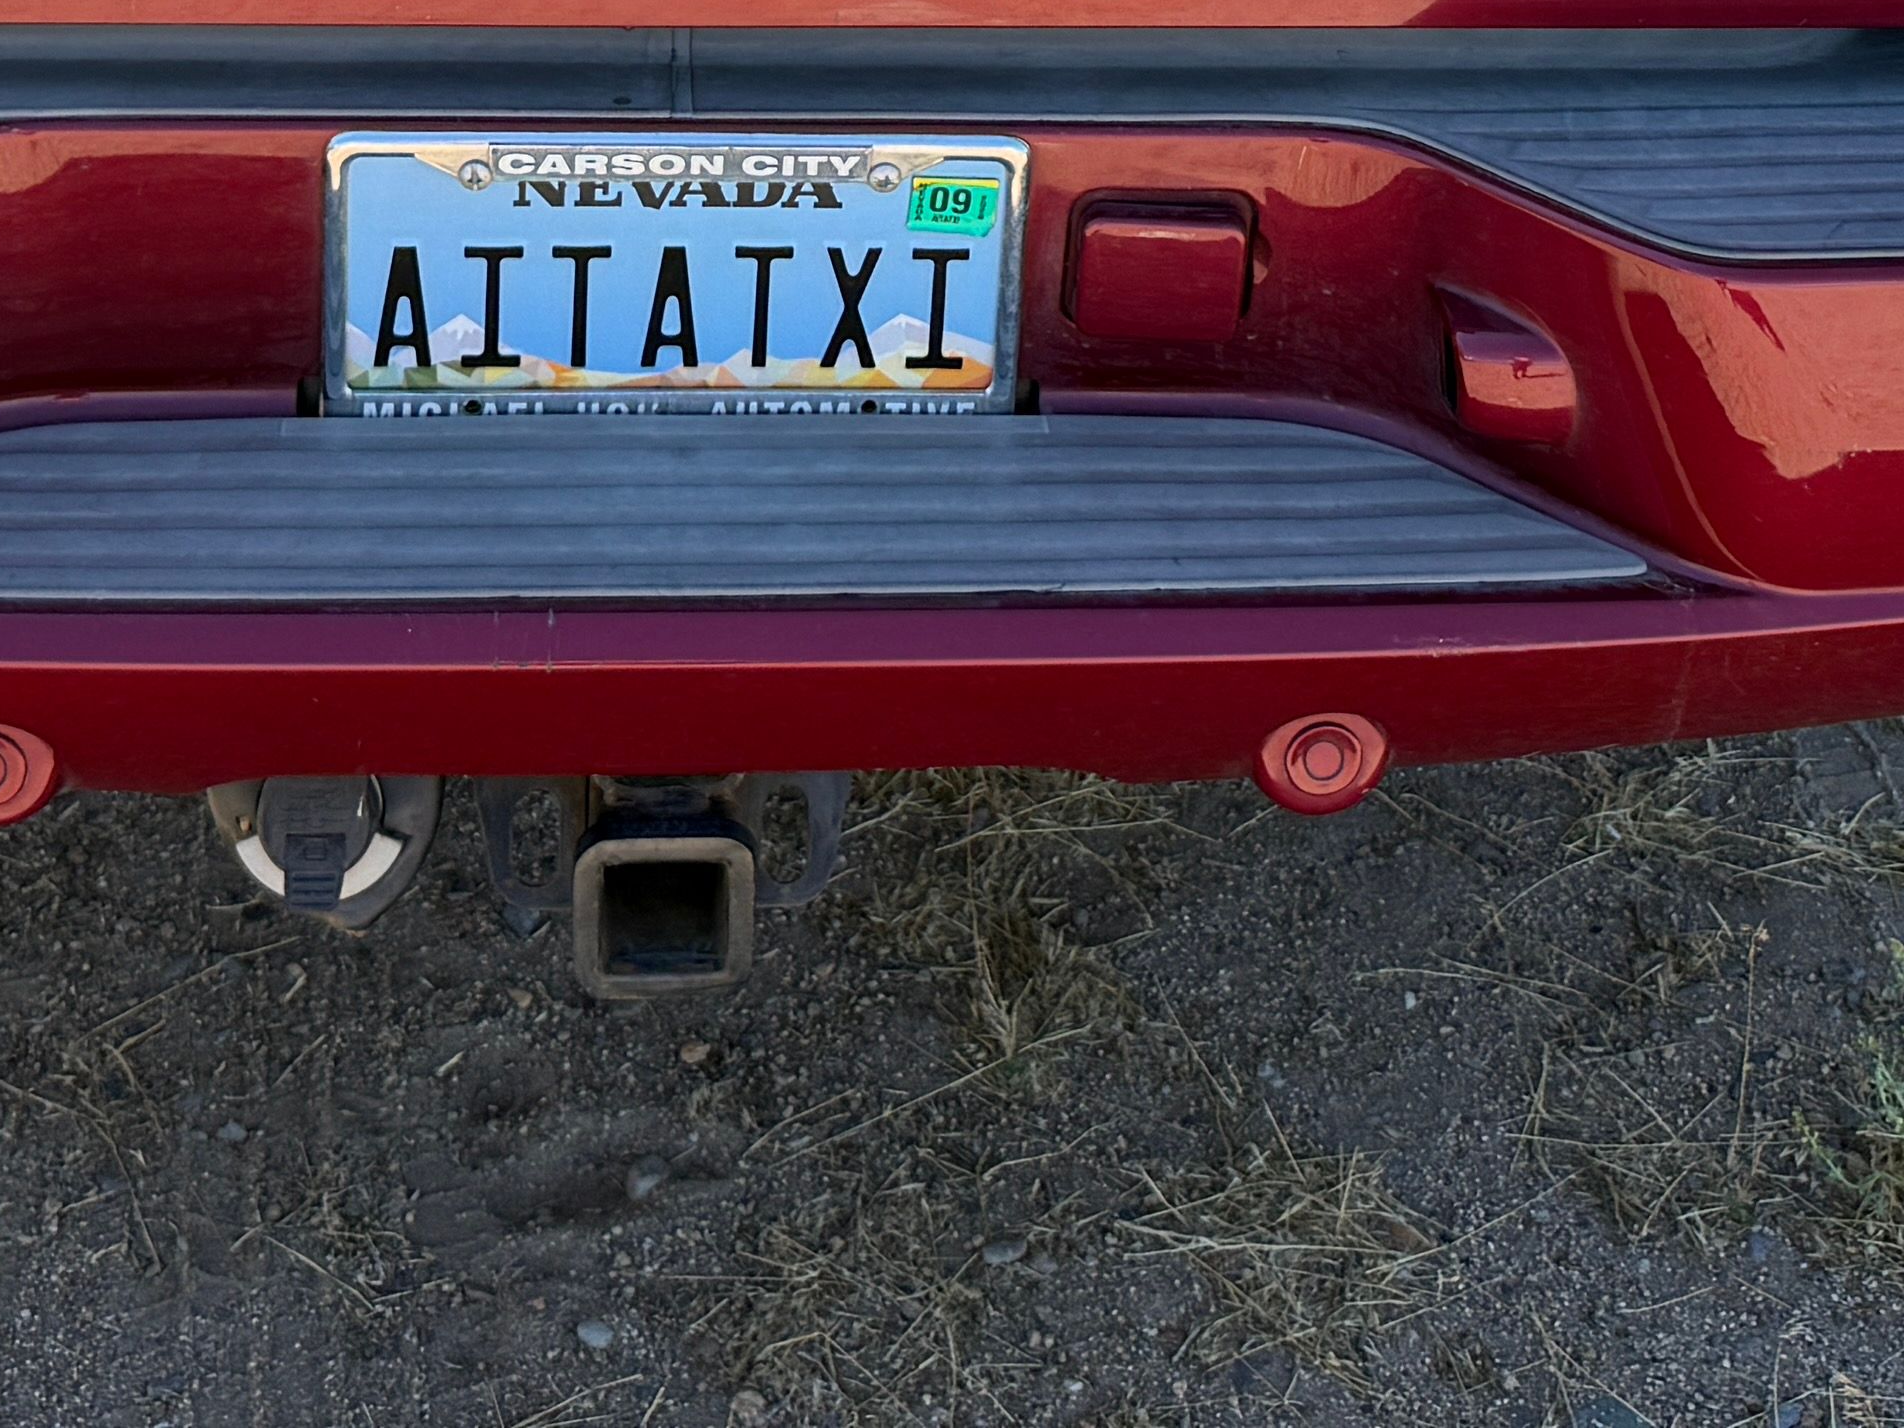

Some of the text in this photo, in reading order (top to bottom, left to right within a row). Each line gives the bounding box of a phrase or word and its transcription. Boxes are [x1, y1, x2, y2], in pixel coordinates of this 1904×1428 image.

[497, 152, 861, 177] CARSON CITY
[512, 180, 843, 210] NEVADA
[929, 186, 972, 215] 09
[373, 246, 971, 369] AITATXI
